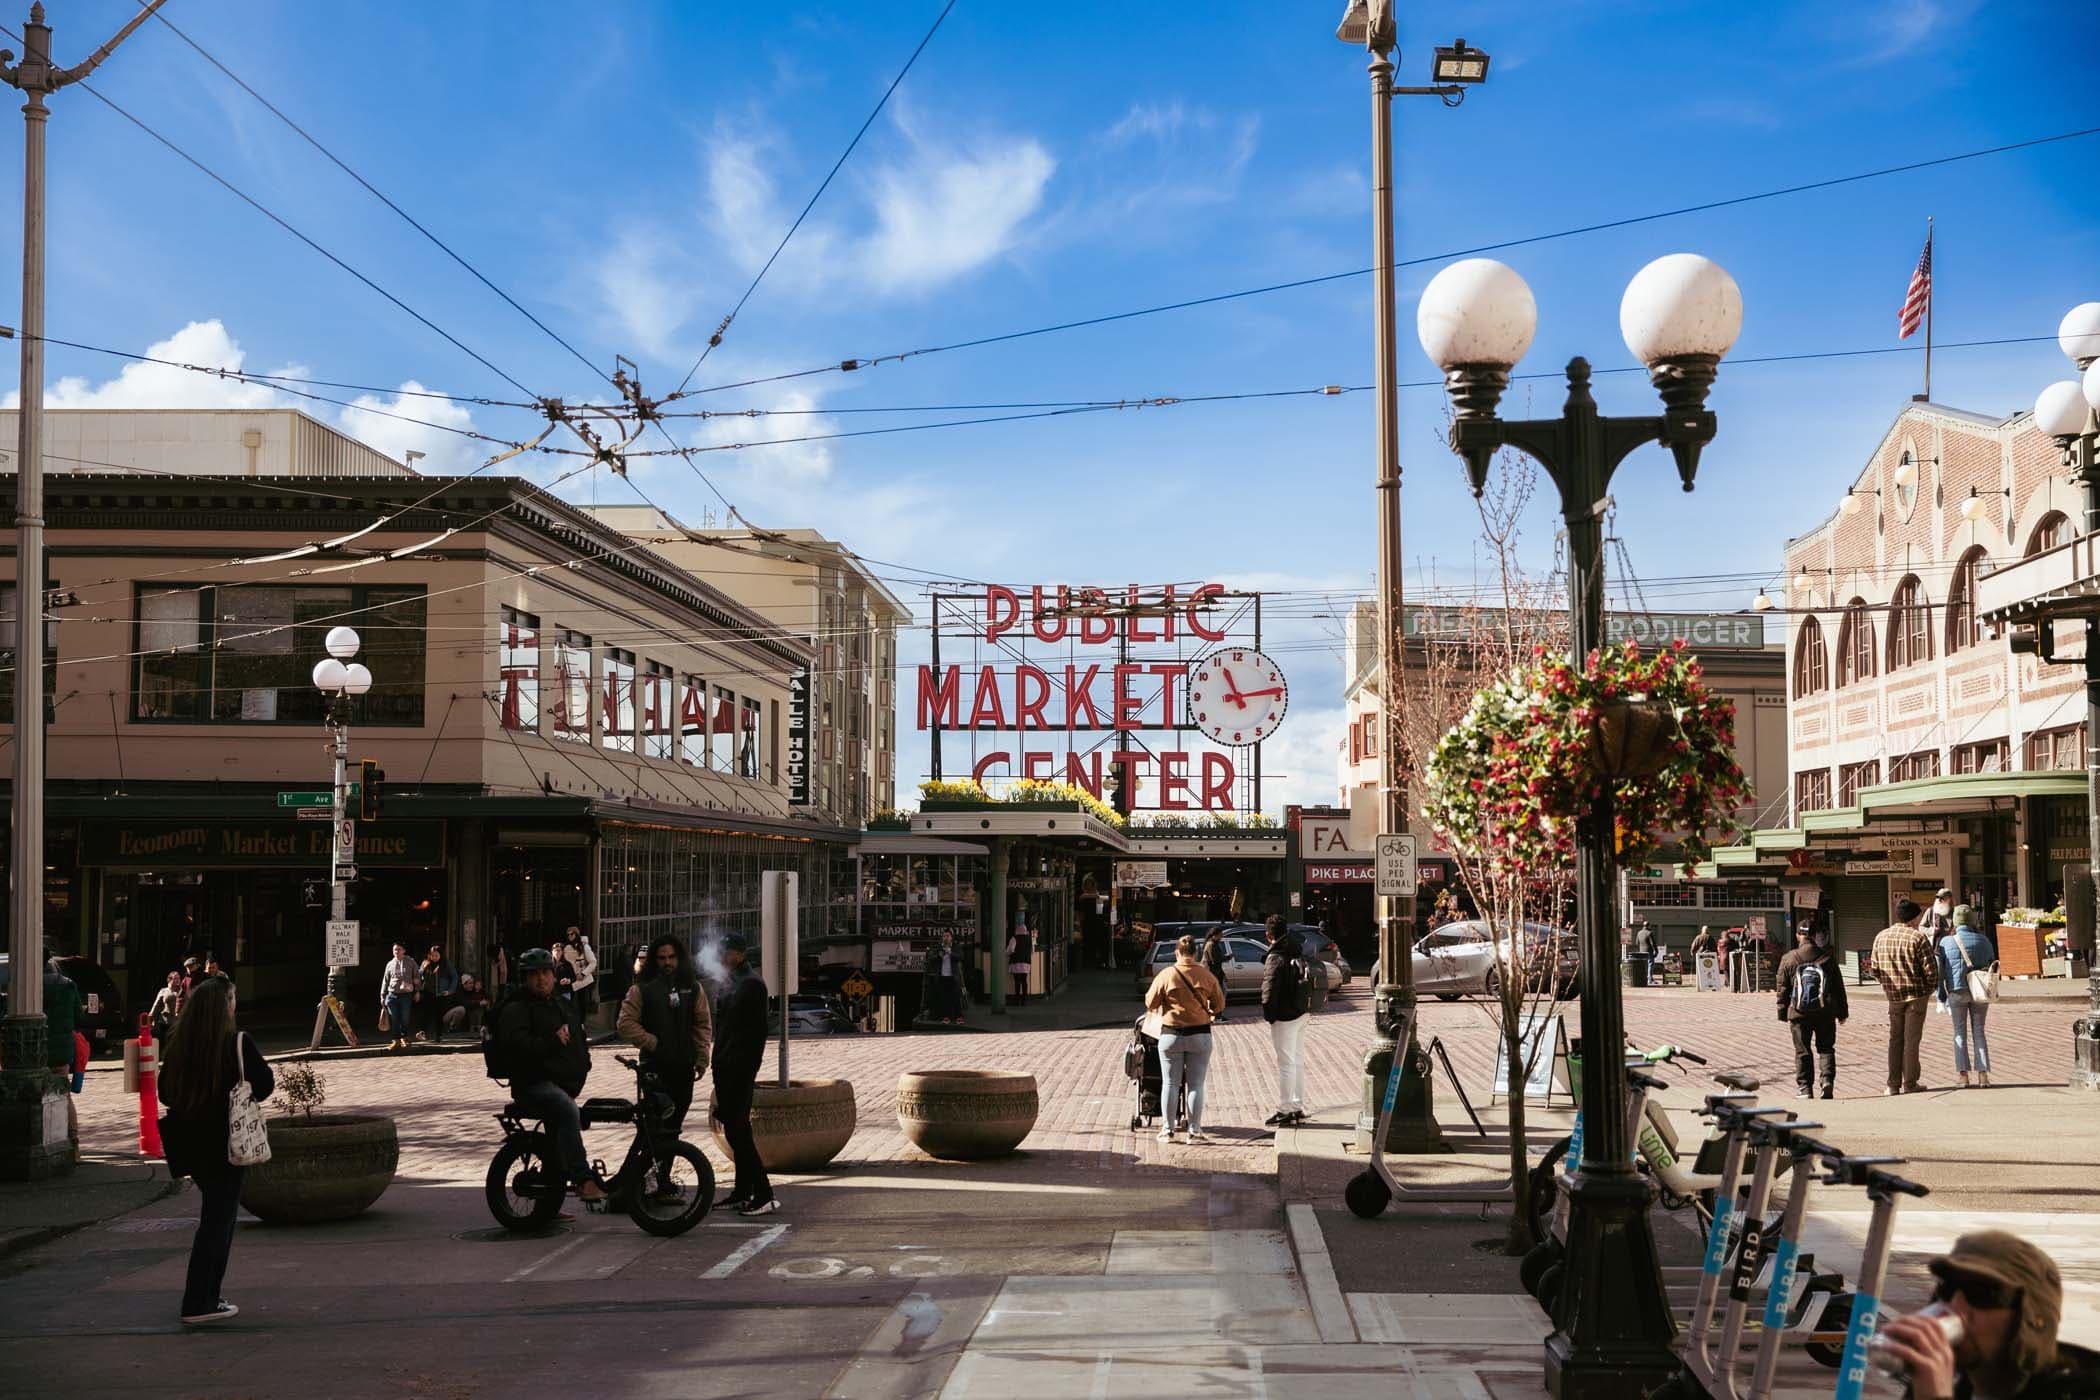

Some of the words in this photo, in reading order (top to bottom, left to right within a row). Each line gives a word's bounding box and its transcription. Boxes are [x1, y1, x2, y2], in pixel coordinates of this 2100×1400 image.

[986, 583, 1225, 645] PUBLIC
[1232, 652, 1243, 662] 12
[1213, 658, 1221, 667] 11
[1199, 672, 1208, 681] 10
[1269, 672, 1276, 681] 2
[917, 663, 1189, 731] MARKET
[1193, 692, 1201, 702] 9
[1199, 712, 1206, 722] 8
[1268, 712, 1276, 722] 4
[1214, 727, 1221, 737] 7
[1255, 727, 1262, 736] 5
[1234, 732, 1241, 742] 6
[788, 737, 804, 800] HOTEL
[314, 795, 329, 804] Ave
[119, 827, 209, 856] Economy
[222, 830, 297, 856] Market
[1923, 836, 1955, 847] books
[1388, 859, 1404, 868] USE
[1311, 867, 1340, 880] PIKE
[1344, 867, 1376, 880] PLAC
[1388, 869, 1404, 878] PED
[1381, 879, 1411, 888] SIGNAL
[331, 923, 342, 931] ALL
[877, 926, 922, 937] MARKET
[1712, 1213, 1734, 1264] BIRD
[1737, 1231, 1761, 1288] BIRD
[1848, 1311, 1876, 1383] BIRD
